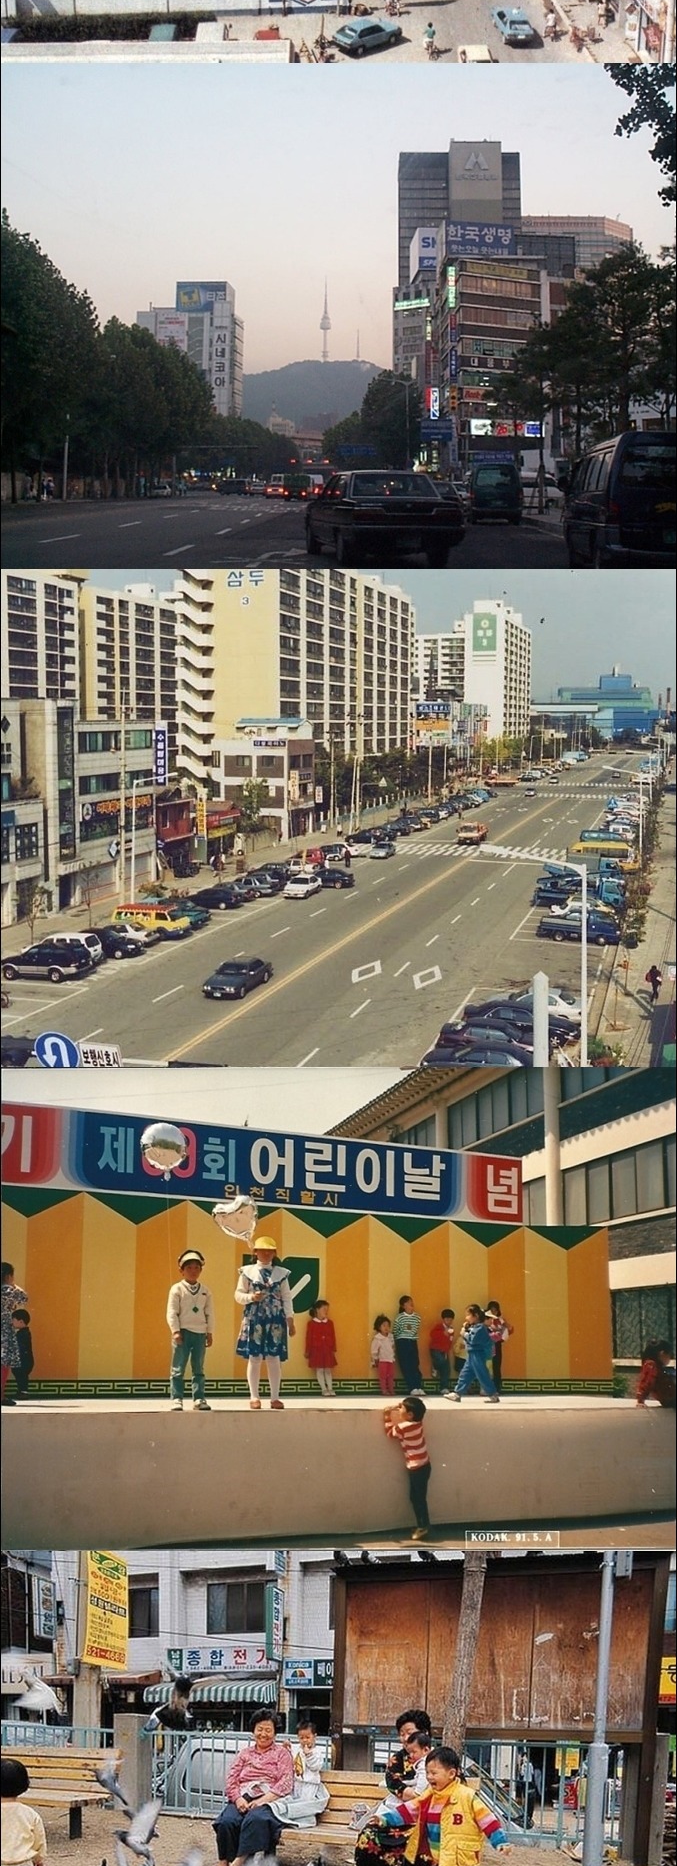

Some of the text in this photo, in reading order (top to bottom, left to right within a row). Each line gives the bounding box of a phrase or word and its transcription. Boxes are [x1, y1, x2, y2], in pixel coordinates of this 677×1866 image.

[447, 224, 512, 245] 한국생명
[214, 333, 227, 387] 시네코아
[226, 570, 264, 589] 삼두
[241, 596, 250, 606] 3
[81, 1049, 121, 1067] 보행신호시
[249, 1136, 445, 1202] 어린이날
[224, 1184, 339, 1207] 인천직할시
[484, 1165, 521, 1217] 념
[288, 1661, 310, 1669] Konica
[453, 1813, 463, 1826] B
